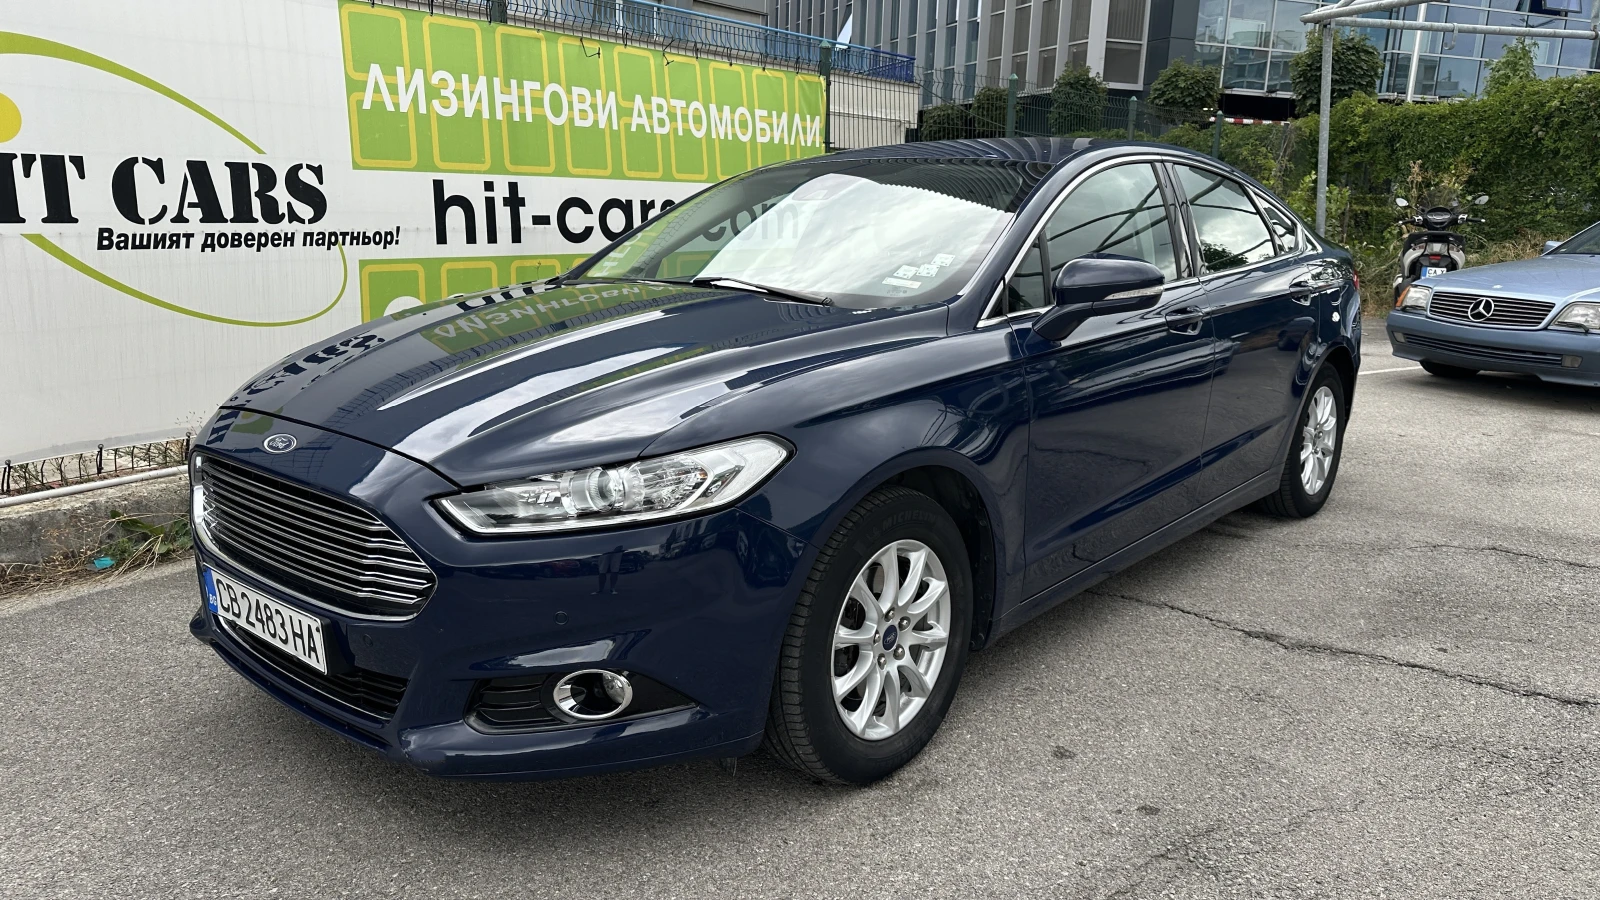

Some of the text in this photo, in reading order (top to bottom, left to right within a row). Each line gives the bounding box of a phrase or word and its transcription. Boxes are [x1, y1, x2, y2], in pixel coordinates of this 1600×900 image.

[362, 63, 821, 147] ЛИЗИНГОВИ АВТОМОБИЛИ
[111, 156, 328, 225] CARS
[97, 226, 401, 252] Вашият доверен партньор!
[209, 593, 217, 604] BG
[215, 577, 320, 664] CB 2483 HA
